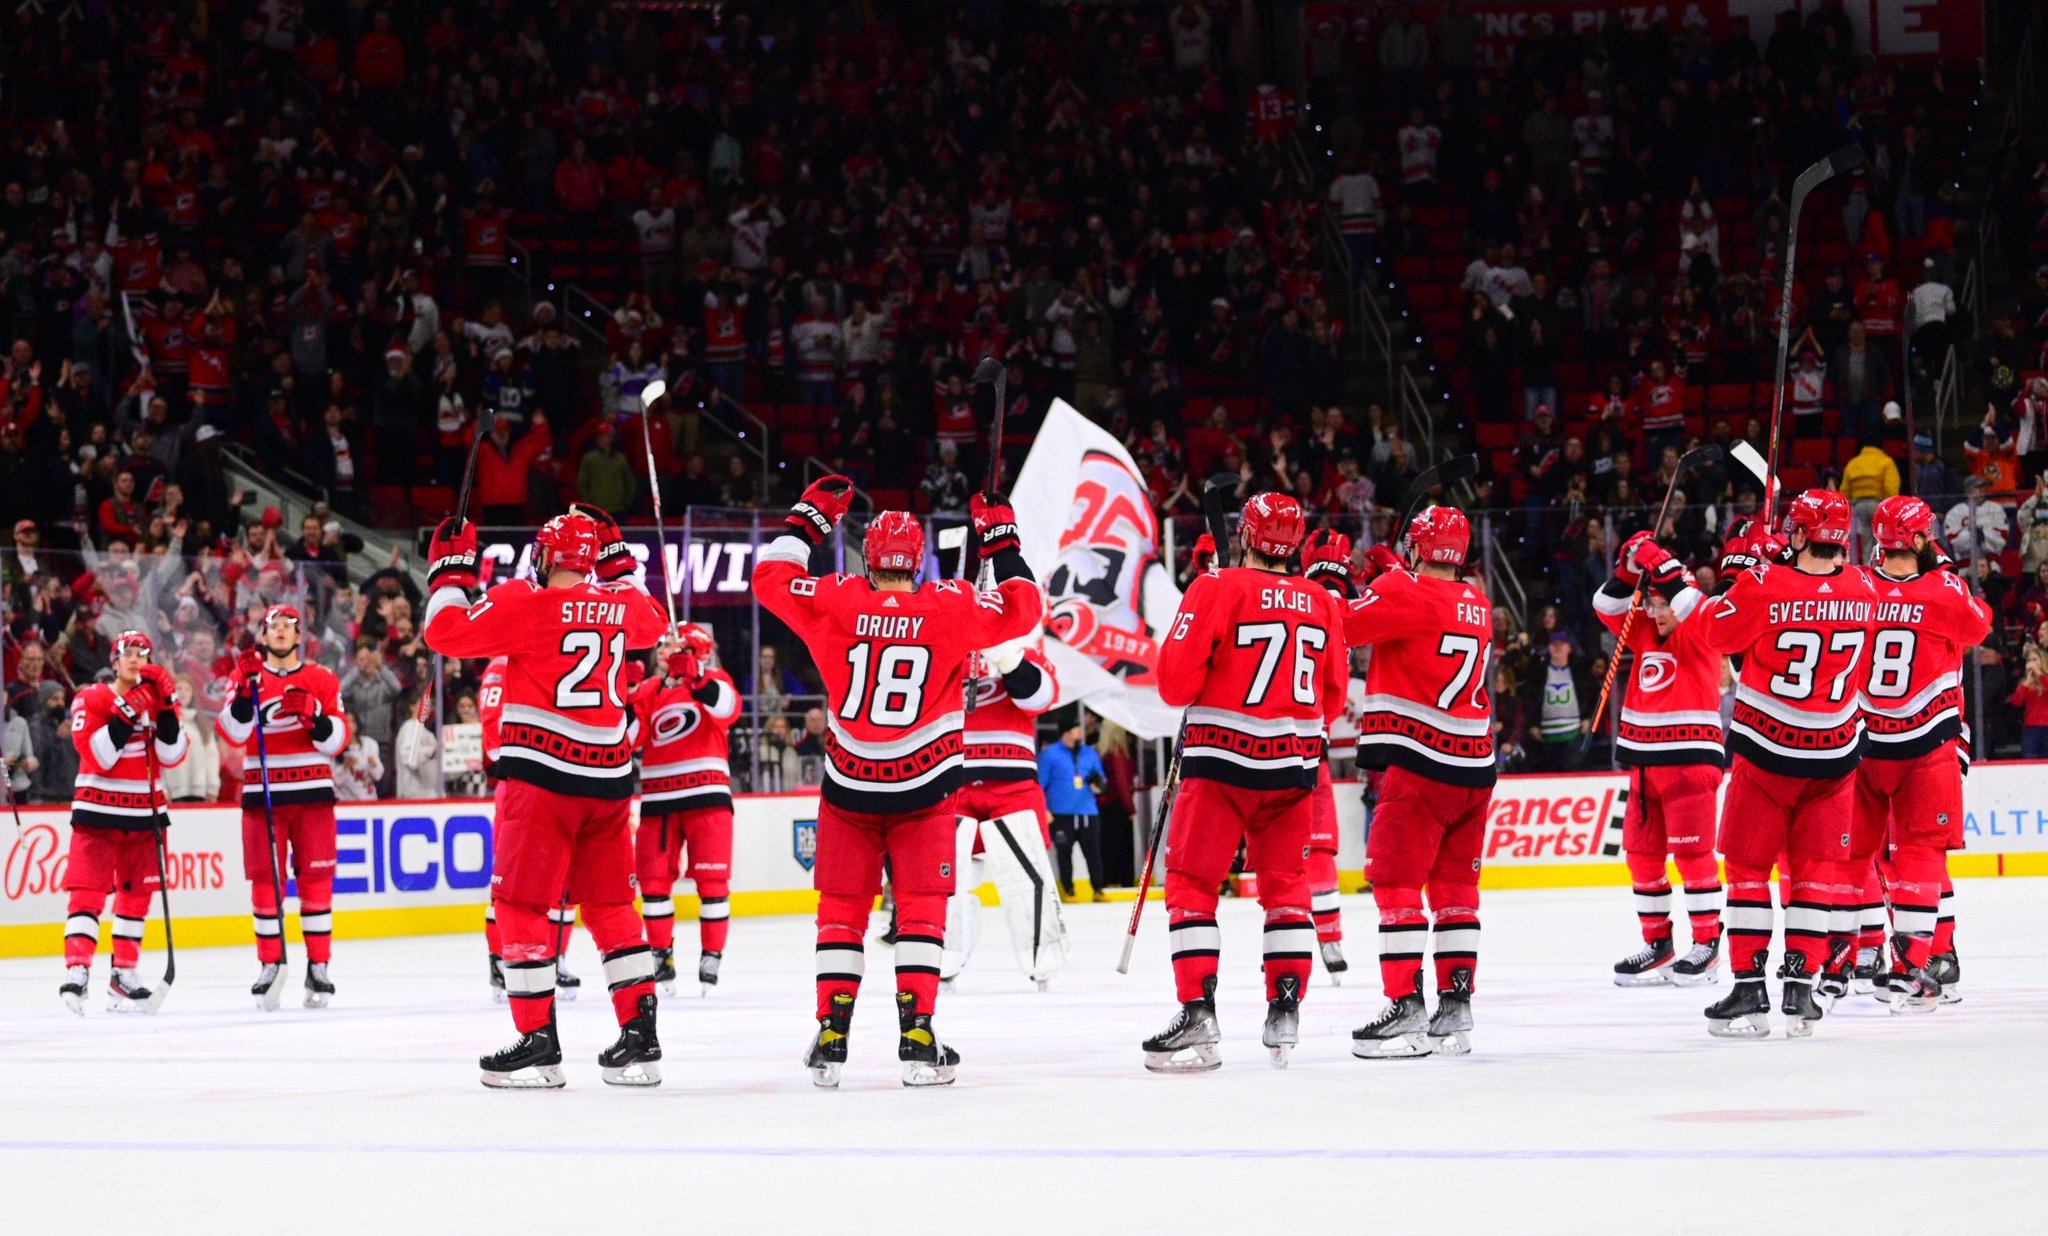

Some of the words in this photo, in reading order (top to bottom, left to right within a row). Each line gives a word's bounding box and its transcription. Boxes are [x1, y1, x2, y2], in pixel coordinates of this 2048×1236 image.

[1831, 529, 1844, 541] 37
[578, 543, 592, 557] 21
[892, 554, 904, 567] 18
[1272, 544, 1288, 555] 76
[1443, 548, 1455, 561] 71
[663, 543, 770, 594] WI
[561, 602, 626, 625] STEPAN
[1260, 589, 1312, 614] SKJEI
[1457, 602, 1487, 628] FAST
[1769, 601, 1872, 625] SVECHNIKOV
[1876, 602, 1924, 624] URNS
[855, 613, 924, 640] DRURY
[1103, 629, 1150, 656] 1997
[555, 629, 626, 708] 21
[1235, 620, 1327, 706] 76
[1769, 629, 1865, 702] 37
[1867, 629, 1916, 699] 8
[839, 640, 931, 727] 18
[334, 815, 494, 894] EICO
[1485, 826, 1588, 858] Parts
[165, 852, 225, 890] ORTS
